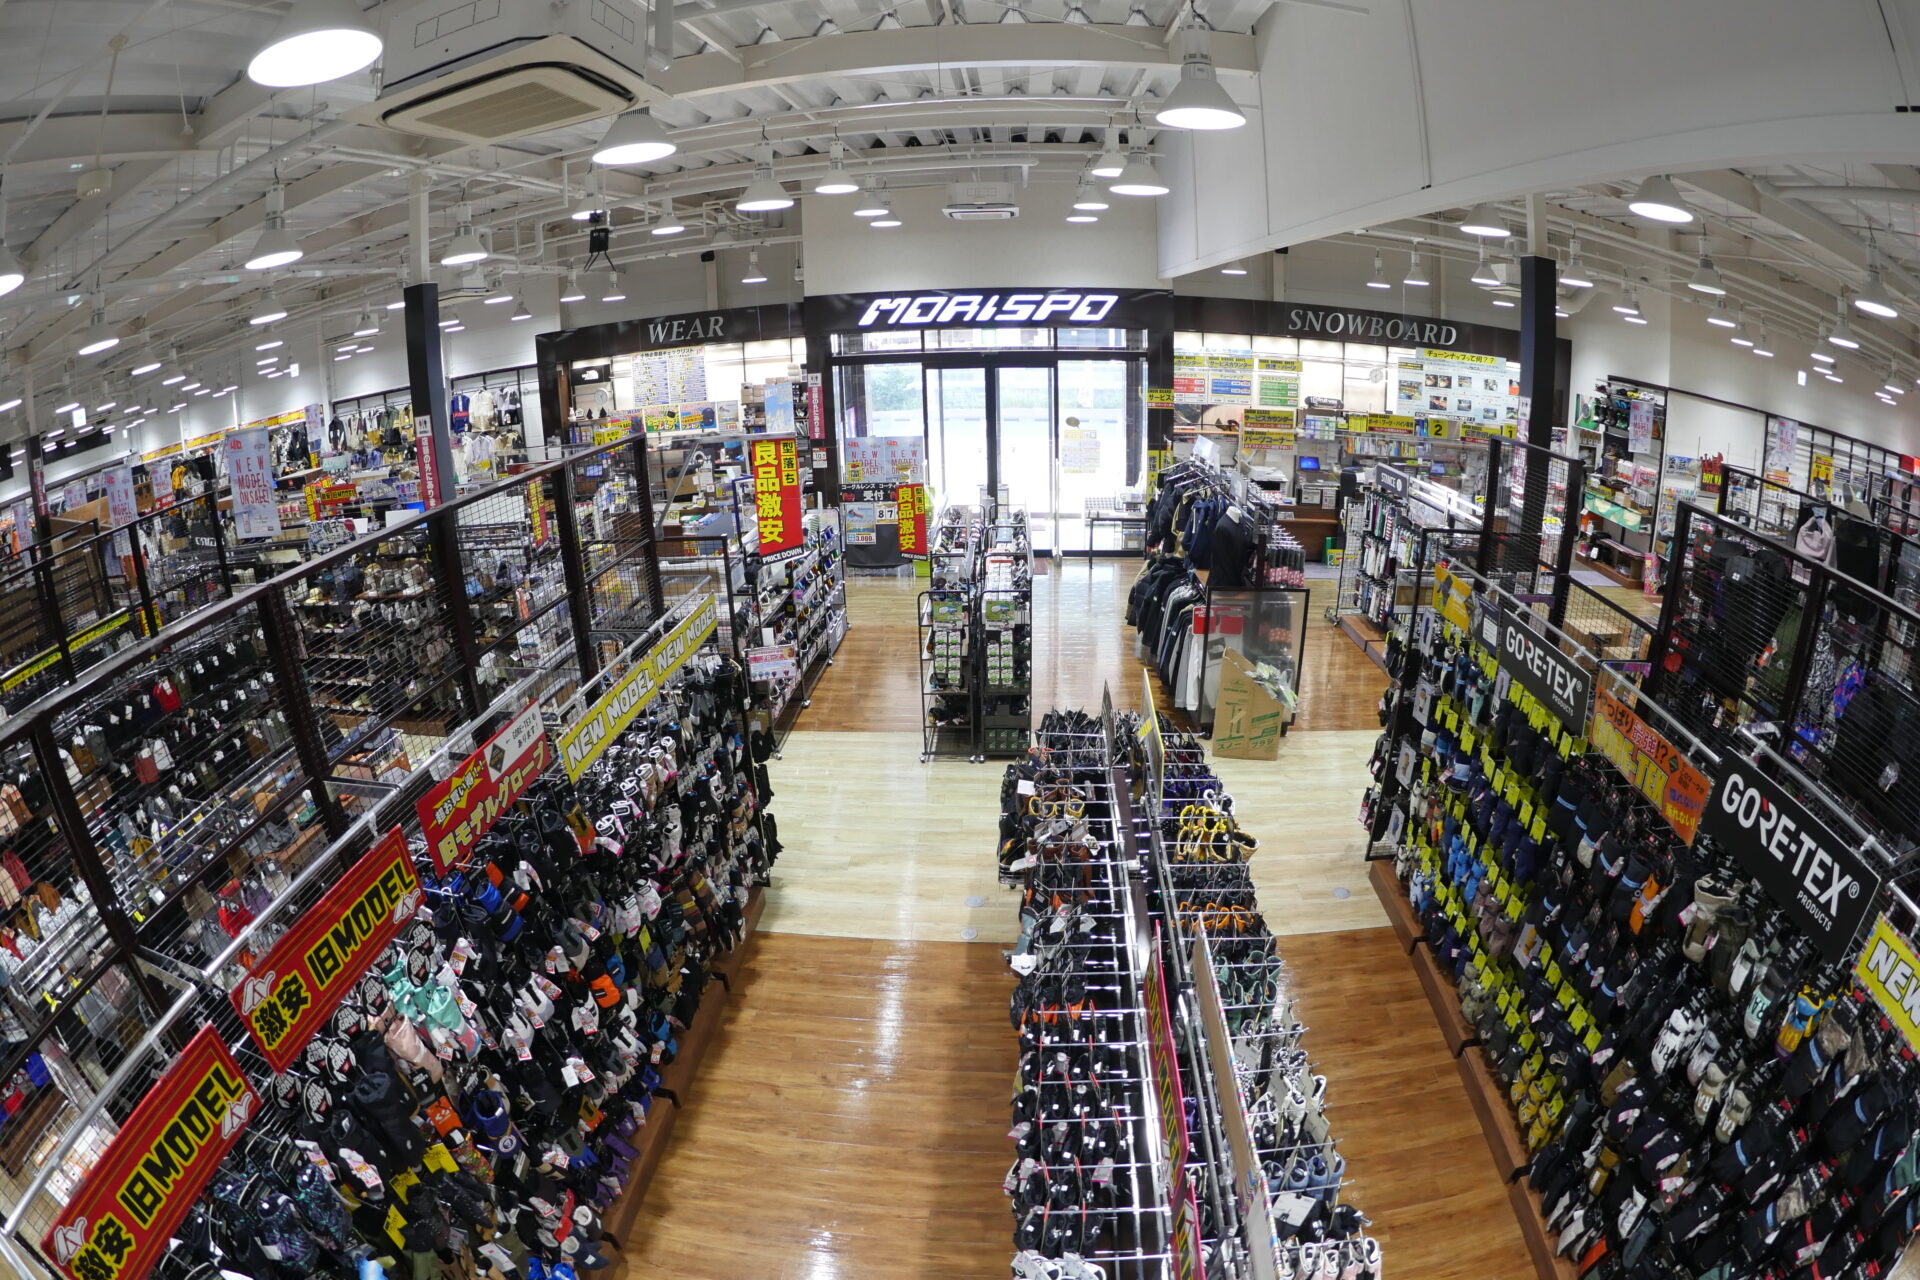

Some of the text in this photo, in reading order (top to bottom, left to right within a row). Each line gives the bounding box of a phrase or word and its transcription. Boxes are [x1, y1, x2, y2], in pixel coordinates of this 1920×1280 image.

[858, 294, 1119, 326] MORISPO
[648, 316, 724, 343] WEAR
[1288, 309, 1457, 346] SNOWBOARD
[1434, 424, 1443, 436] 2
[1508, 430, 1513, 438] 1
[235, 455, 264, 473] NEW
[782, 441, 798, 485] 型落ち
[851, 451, 878, 459] NEW
[891, 450, 918, 458] NEW
[238, 473, 268, 489] MODEL
[754, 441, 784, 544] 良品激安
[863, 490, 885, 501] 受付
[898, 487, 916, 551] 良品激安
[762, 547, 802, 564] PRICE DOWN
[656, 604, 716, 677] NEW MODEL
[566, 668, 656, 770] NEW MODEL
[1552, 693, 1574, 717] PRODUCTS
[438, 741, 544, 867] 旧モデルグローブ
[1797, 890, 1832, 932] PRODUCTS
[254, 859, 416, 1048] 激安 旧MODEL
[117, 1062, 244, 1230] 旧MODEL
